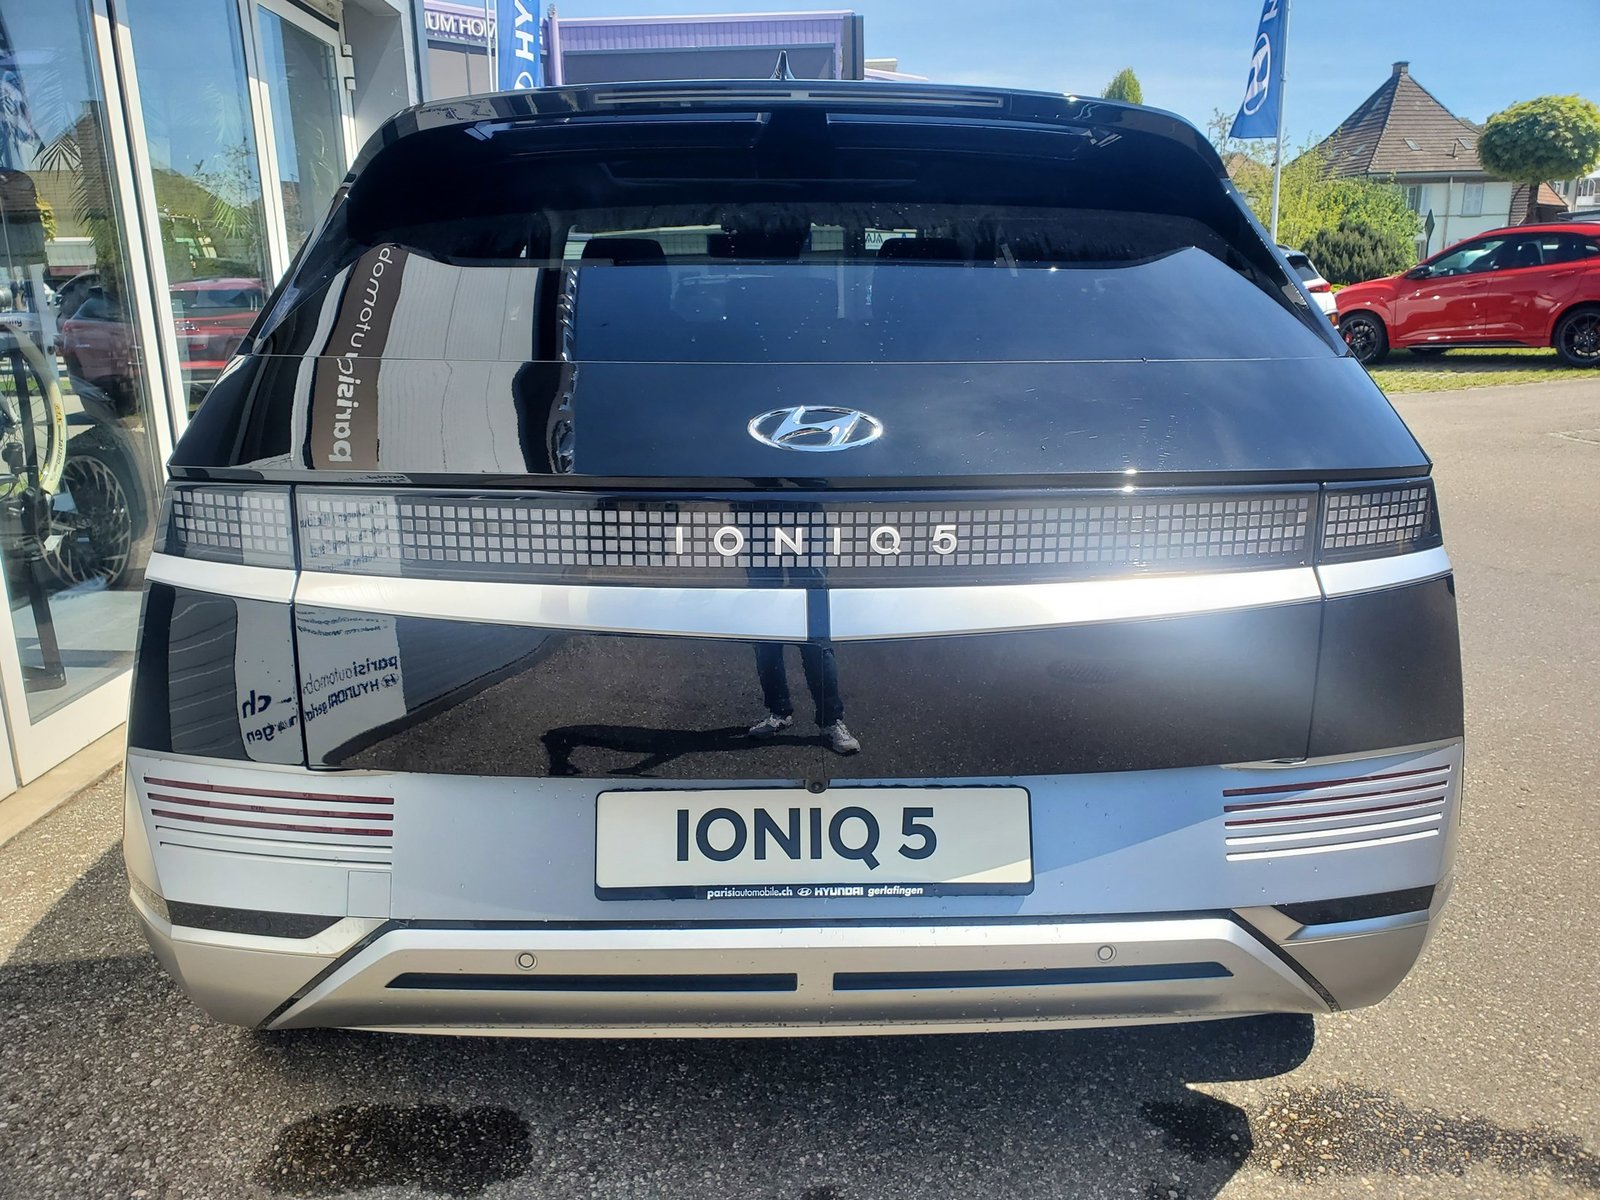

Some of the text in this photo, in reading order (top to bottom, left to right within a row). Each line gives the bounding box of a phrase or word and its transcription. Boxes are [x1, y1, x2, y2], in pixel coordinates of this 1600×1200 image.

[675, 524, 958, 557] IONIQ 5
[676, 806, 937, 871] IONIQ 5
[706, 885, 924, 900] parisiautomobile.ch HYUNDAI gerlafingen
